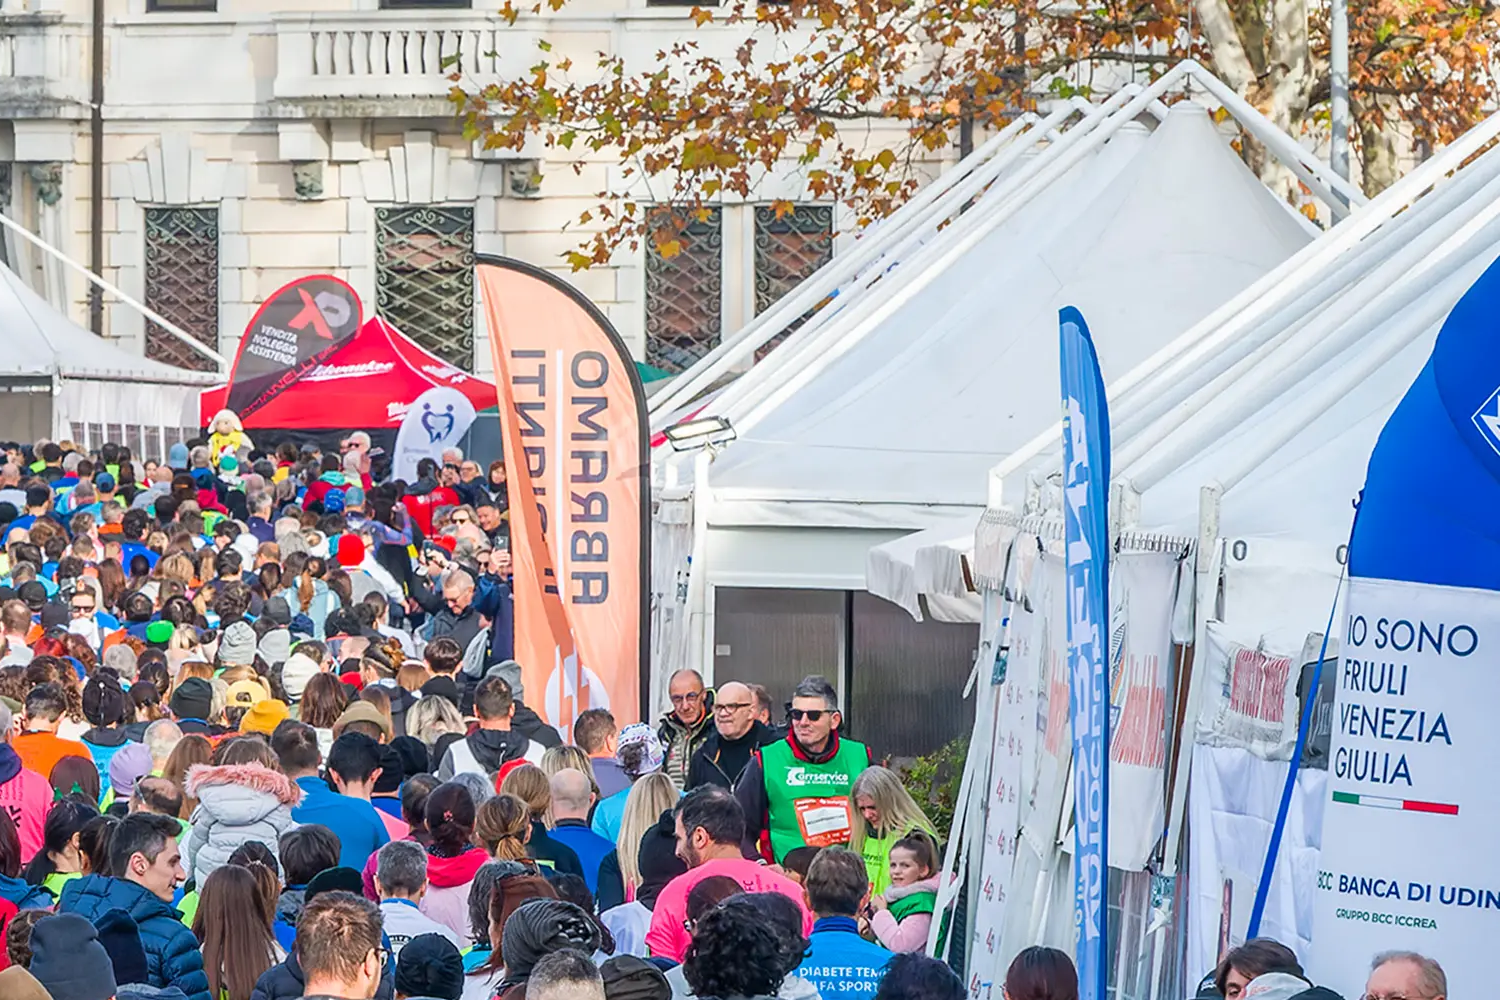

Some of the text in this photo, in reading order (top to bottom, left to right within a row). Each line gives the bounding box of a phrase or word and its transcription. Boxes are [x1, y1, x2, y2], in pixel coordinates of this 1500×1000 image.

[252, 334, 299, 354] NOLEGGIO
[261, 324, 298, 343] VENDITA
[247, 344, 297, 366] ASSISTENZA
[1348, 614, 1479, 657] IO SONO
[1343, 658, 1408, 696] FRIULI
[1340, 702, 1452, 746] VENEZIA
[1335, 746, 1413, 786] GIULIA
[1339, 874, 1401, 900] BANCA
[1407, 882, 1431, 903] DI
[1439, 886, 1500, 909] UDIN
[1336, 907, 1438, 930] GRUPPO BCC ICCREA
[800, 967, 888, 977] DIABETE TEM
[820, 981, 835, 991] FA
